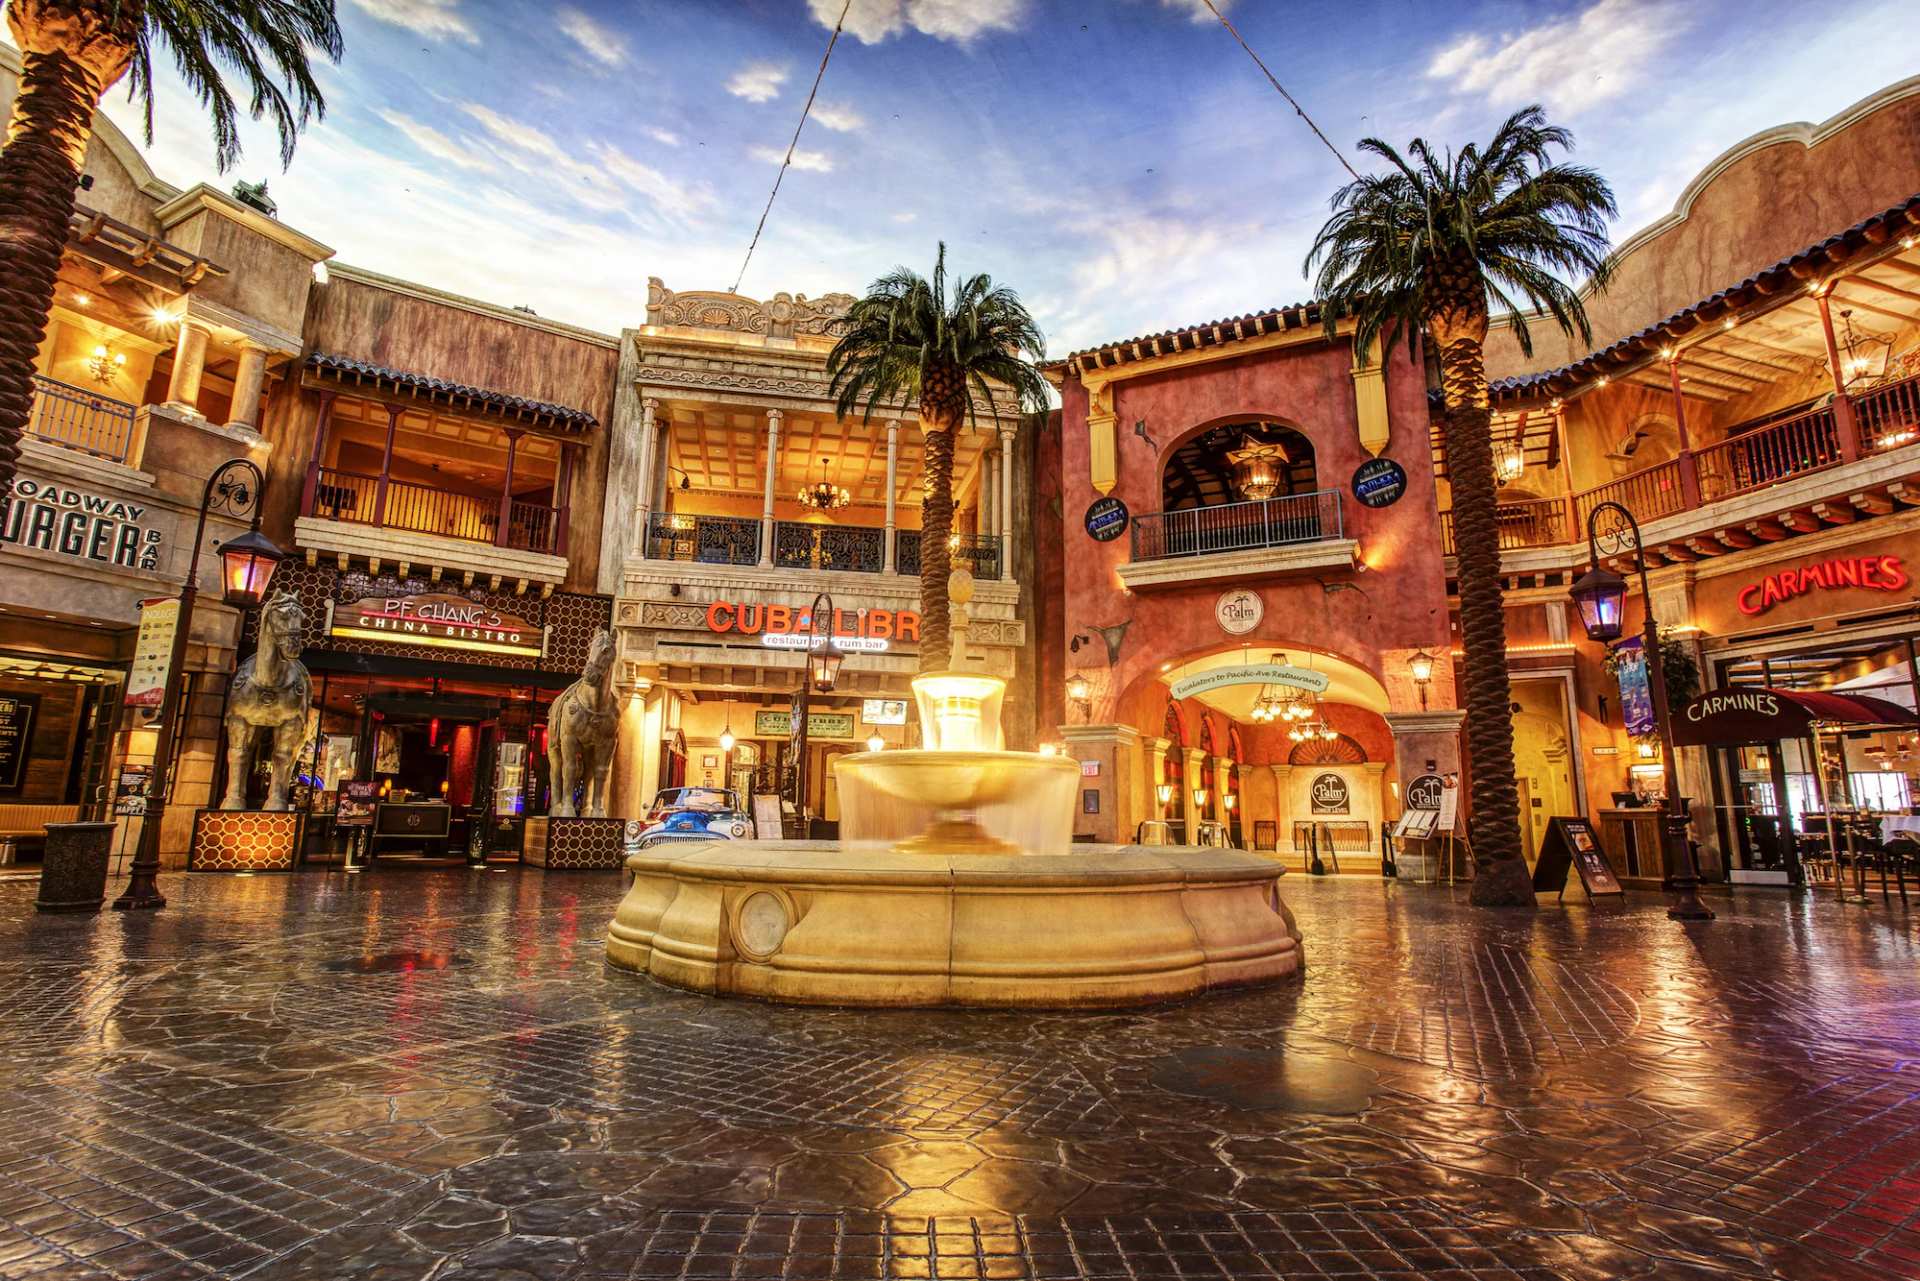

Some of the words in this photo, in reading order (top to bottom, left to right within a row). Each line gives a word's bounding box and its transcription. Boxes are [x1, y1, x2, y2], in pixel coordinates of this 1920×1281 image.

[15, 479, 145, 522] OADWAY
[0, 499, 140, 568] URGER
[140, 528, 161, 571] BAR
[418, 602, 502, 628] CHANG'S
[705, 601, 818, 634] CUBA
[1222, 595, 1254, 619] Palm
[359, 616, 429, 632] CHINA
[447, 626, 520, 643] BISTRO
[839, 640, 862, 649] rum
[865, 640, 884, 649] bar
[1271, 670, 1322, 686] Restaurants
[1313, 776, 1343, 799] Palm
